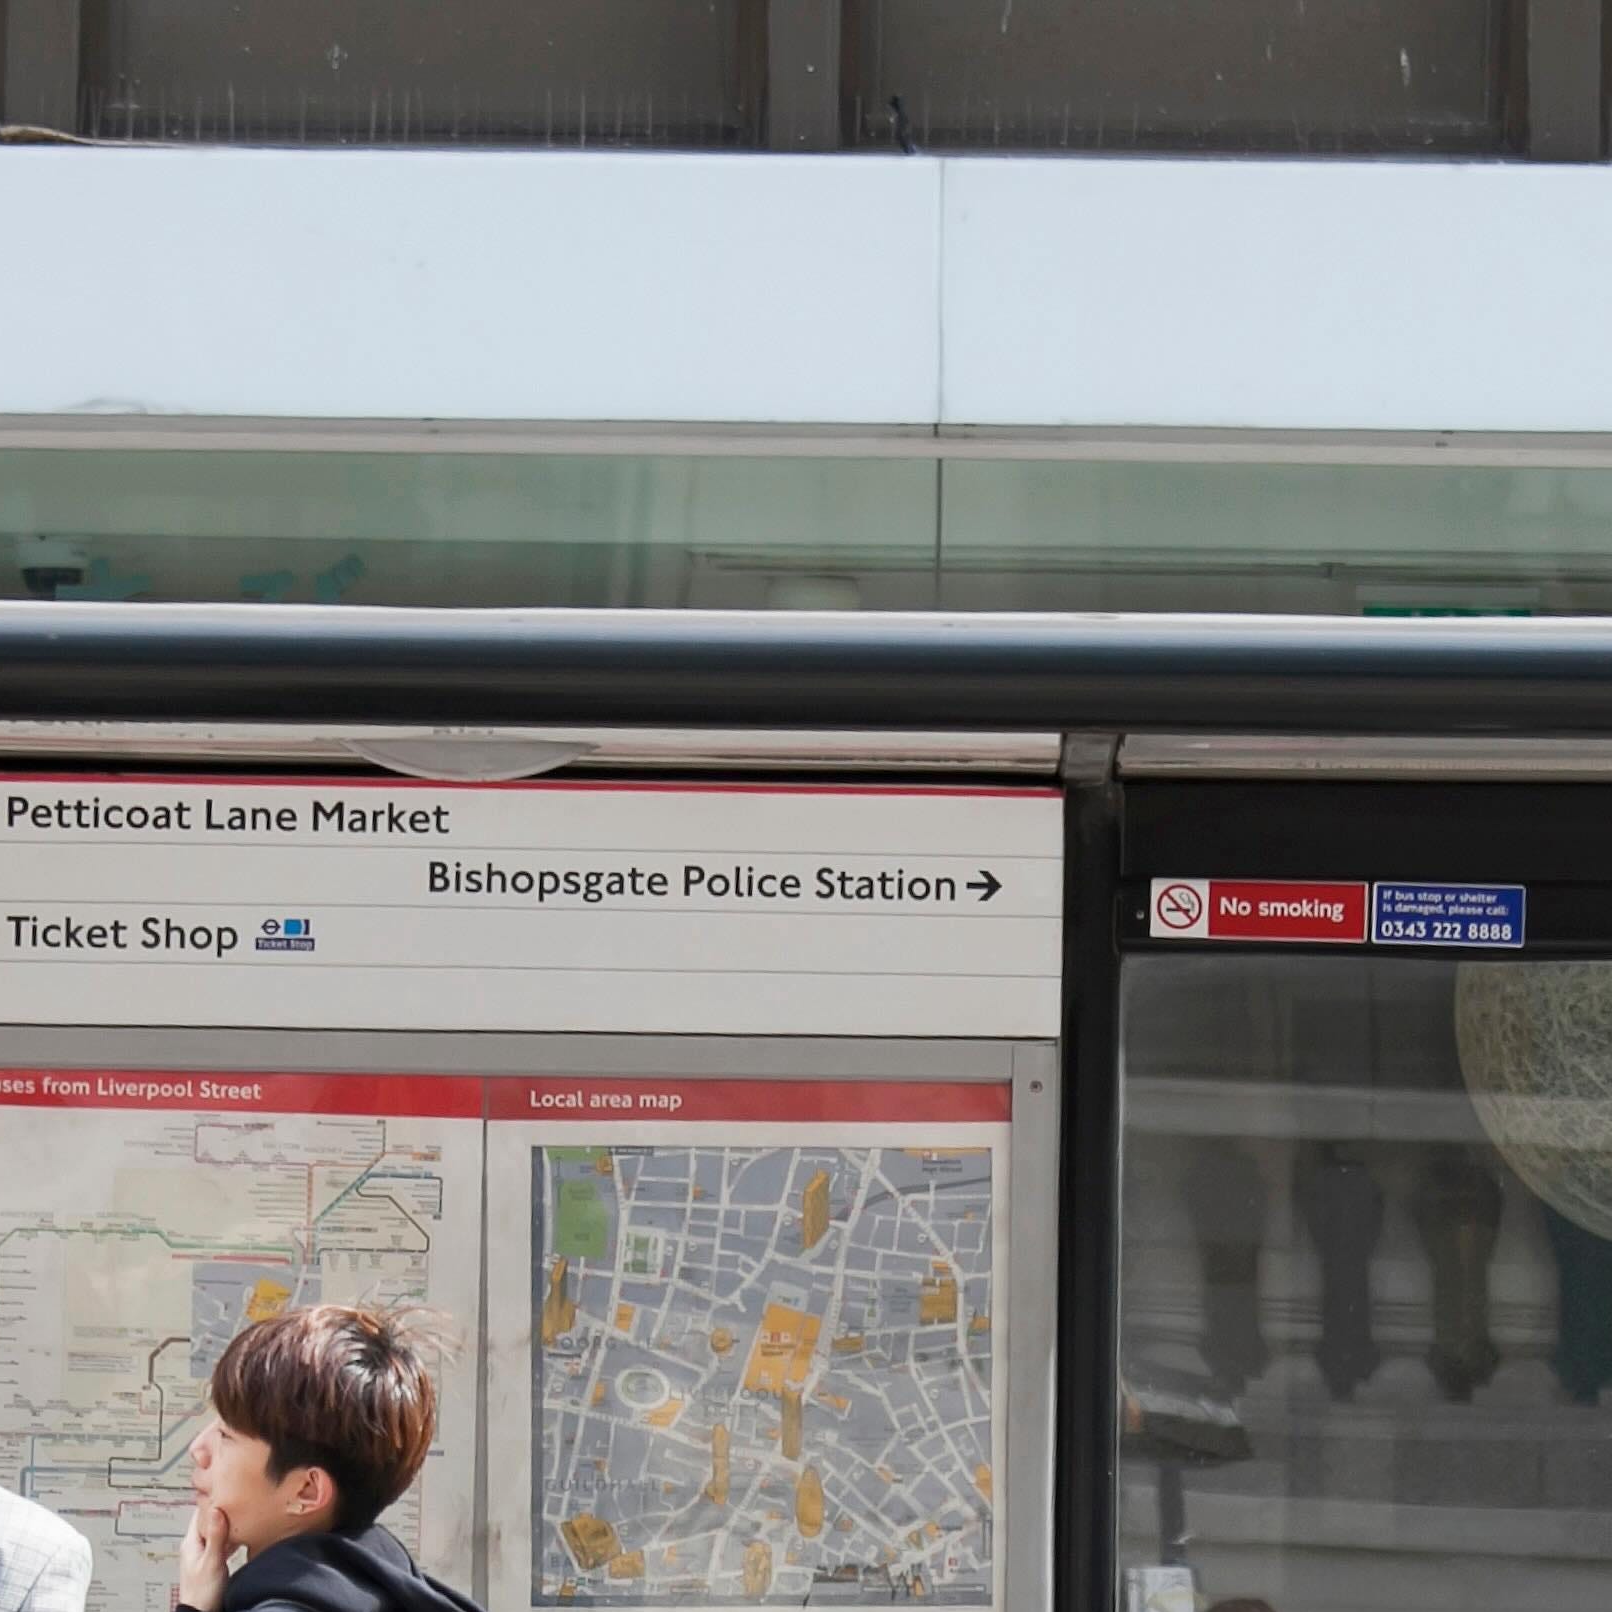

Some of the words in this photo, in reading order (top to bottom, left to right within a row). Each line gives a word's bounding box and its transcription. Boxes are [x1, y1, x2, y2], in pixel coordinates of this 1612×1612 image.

[7, 796, 192, 830] Petticoat
[205, 799, 297, 831] Lane
[312, 801, 450, 834] Market
[429, 861, 669, 903] Bishopsgate
[683, 865, 801, 898] Police
[815, 867, 956, 901] Station
[1219, 897, 1252, 917] No
[1258, 898, 1345, 921] smoking
[1395, 891, 1415, 901] bus
[1417, 892, 1442, 903] stop
[1444, 894, 1456, 902] or
[1459, 893, 1498, 904] shelter
[1448, 905, 1483, 917] please
[7, 916, 128, 948] Ticket
[141, 917, 238, 957] Shop
[1381, 921, 1426, 938] 0343
[1432, 922, 1462, 939] 222
[1468, 923, 1512, 940] 8888
[43, 1077, 90, 1096] from
[97, 1078, 193, 1100] Liverpool
[199, 1080, 262, 1100] Street
[530, 1089, 584, 1108] Local
[589, 1093, 633, 1109] area
[639, 1094, 682, 1113] map
